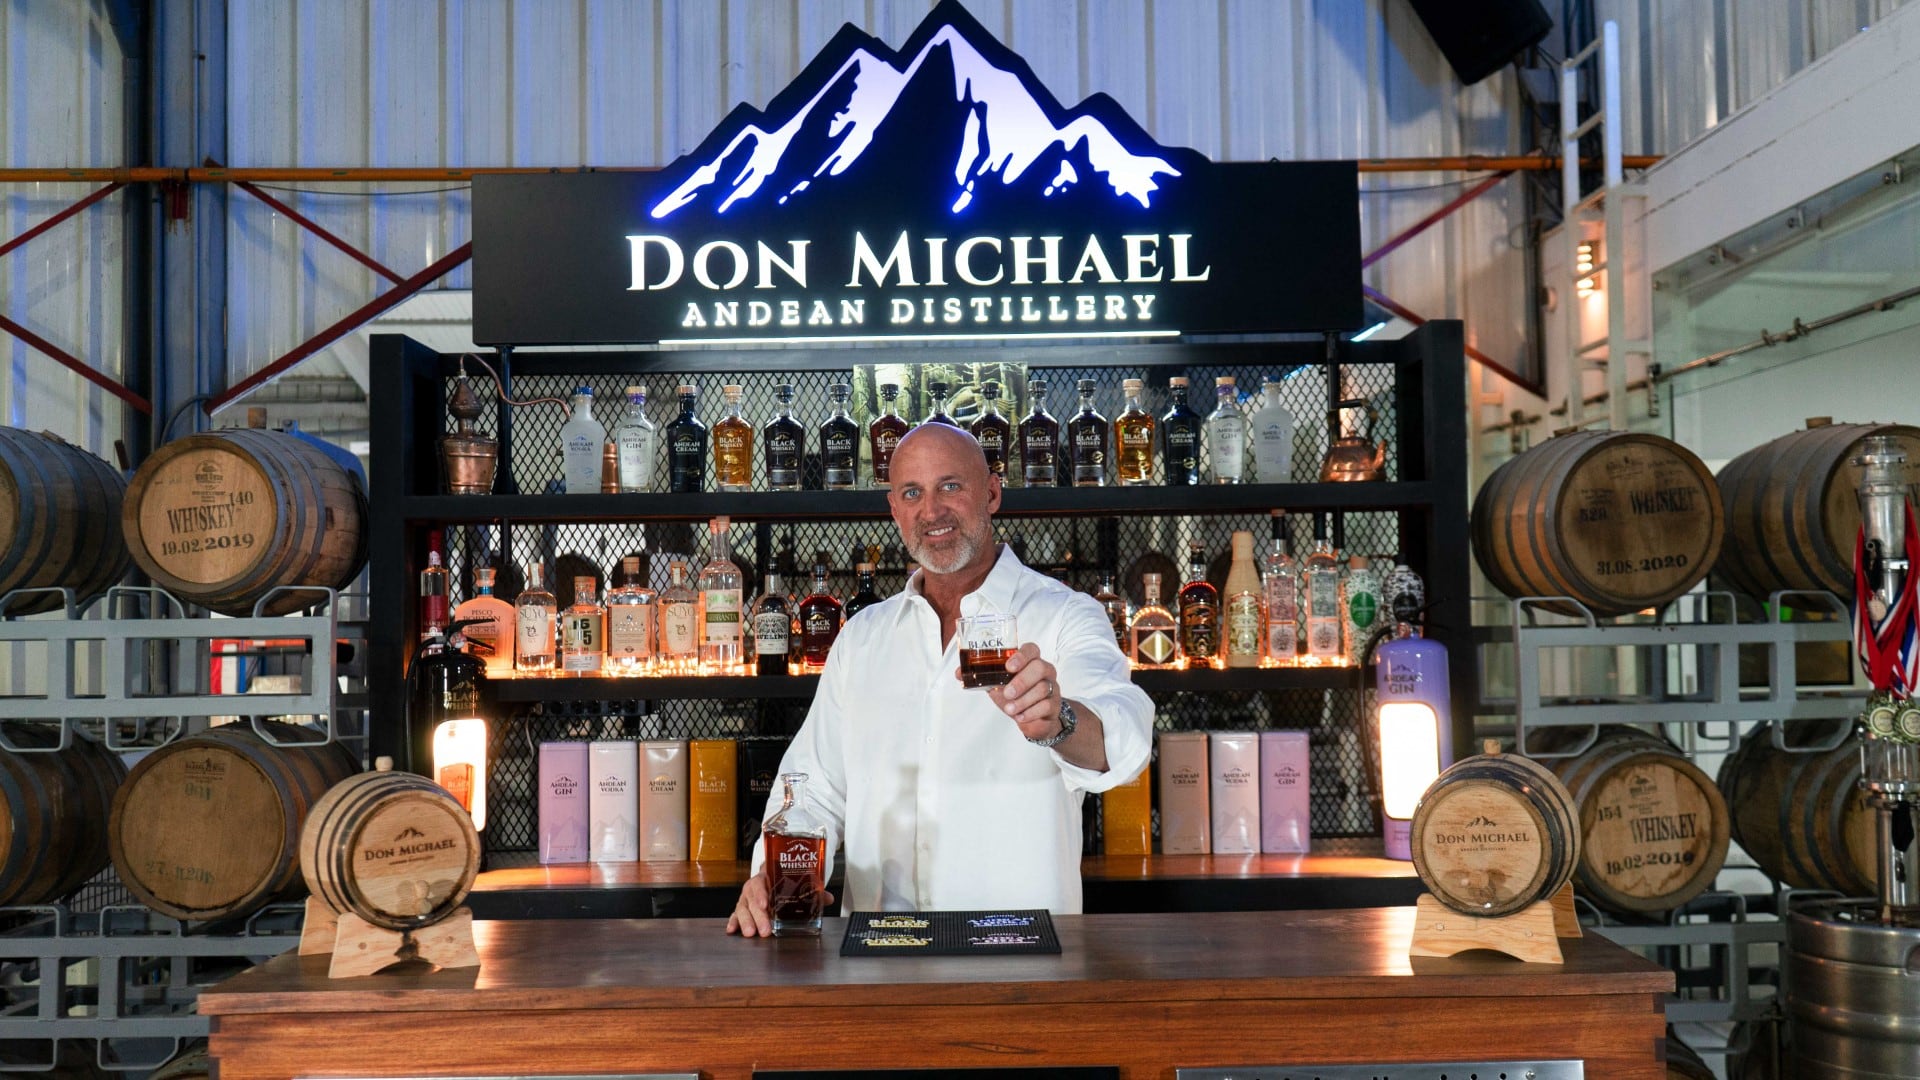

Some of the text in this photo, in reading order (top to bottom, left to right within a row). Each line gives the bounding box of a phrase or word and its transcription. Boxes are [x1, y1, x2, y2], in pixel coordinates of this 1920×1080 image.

[626, 230, 1210, 291] DON MICHAEL
[682, 294, 1156, 327] ANDEAN DISTILLERY
[229, 491, 254, 506] 140
[1629, 486, 1697, 515] WHISKEY
[167, 504, 234, 534] WHISKEY
[161, 534, 255, 556] 19.02.2019
[1596, 554, 1689, 576] 31.08.2020
[968, 636, 1004, 650] BLACK
[1388, 682, 1415, 694] GIN
[698, 779, 728, 788] BLACK
[750, 779, 773, 787] BLAC
[1630, 813, 1697, 844] WHISKEY
[1436, 832, 1530, 845] DON MICHAEL
[364, 848, 395, 861] DON
[399, 839, 457, 856] MICHAEL
[779, 851, 819, 862] BLACK
[779, 861, 819, 869] WHISKEY
